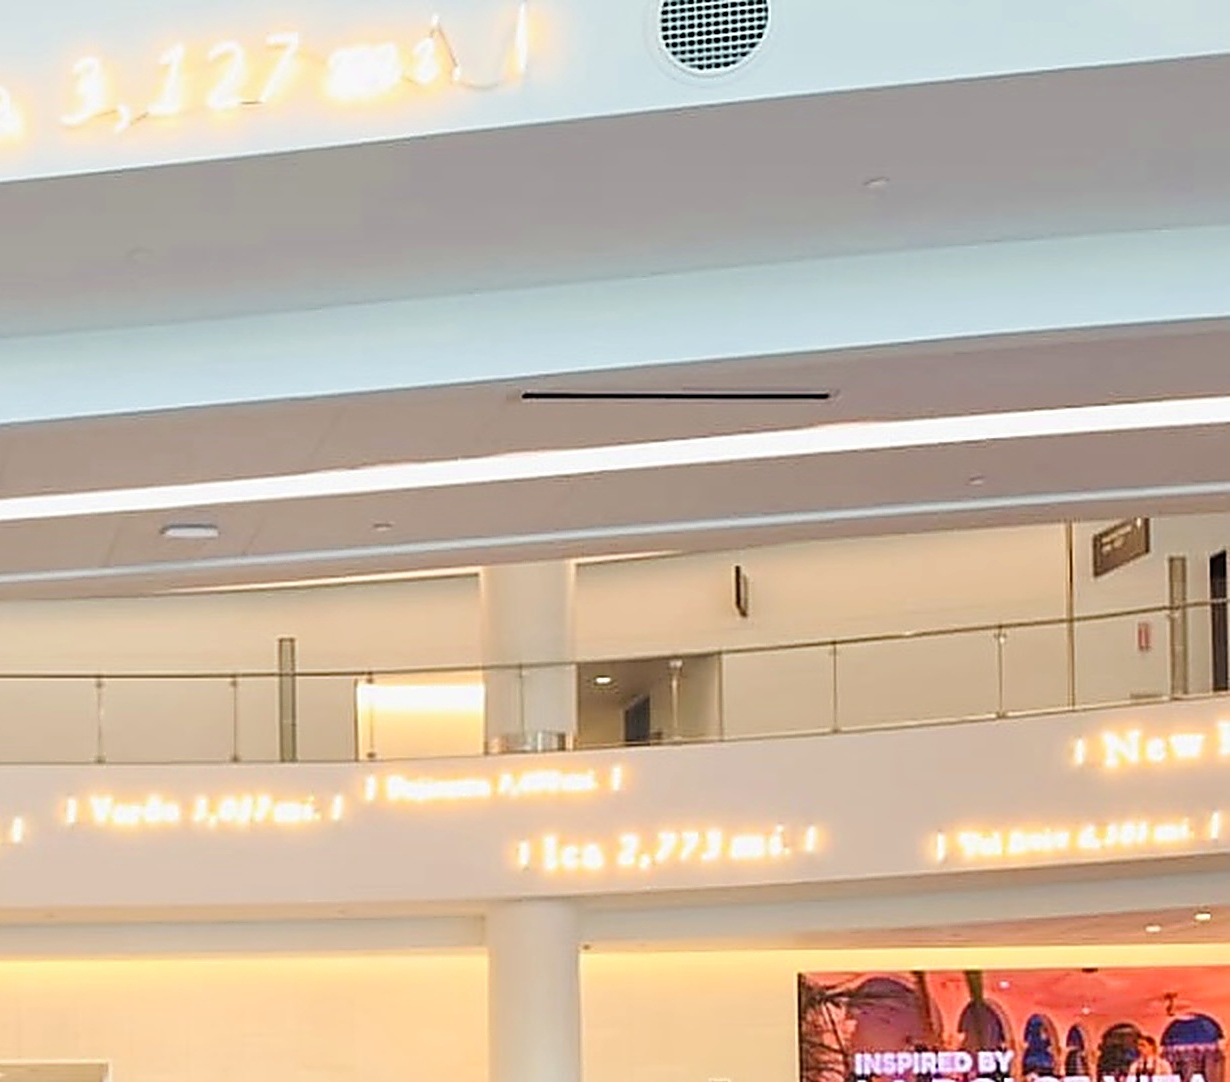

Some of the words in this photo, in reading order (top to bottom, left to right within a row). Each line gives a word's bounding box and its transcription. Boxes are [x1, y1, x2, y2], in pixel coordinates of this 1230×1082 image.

[59, 33, 302, 134] 3,127
[1103, 729, 1204, 767] New
[542, 834, 603, 871] Ica
[617, 830, 722, 870] 2,773
[855, 1051, 972, 1075] INSPIRED
[978, 1051, 1014, 1074] BY
